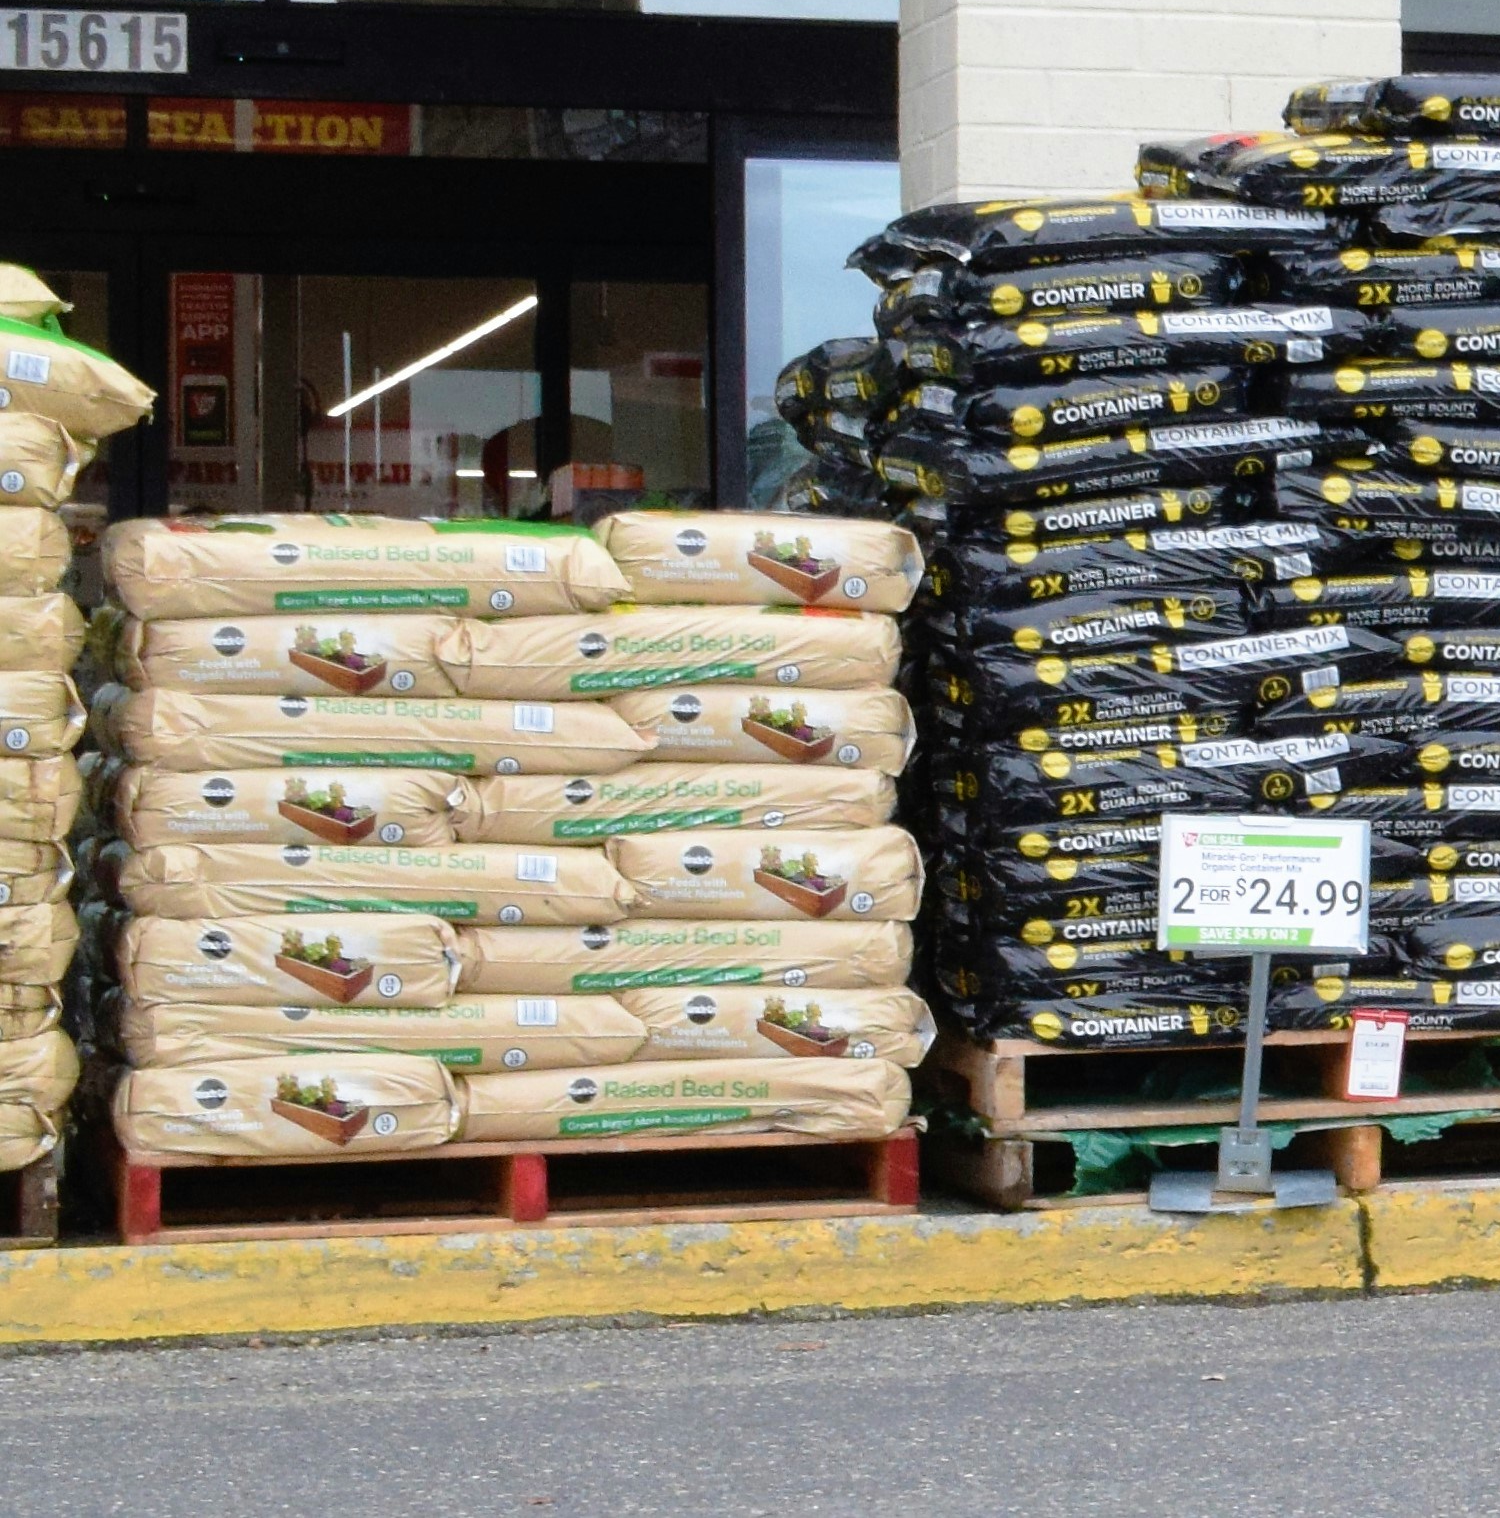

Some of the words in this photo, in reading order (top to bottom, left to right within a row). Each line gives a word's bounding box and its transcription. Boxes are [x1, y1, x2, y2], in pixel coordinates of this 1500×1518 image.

[7, 12, 183, 71] 15615
[20, 107, 384, 149] SATSFATION
[1304, 185, 1336, 205] 2X
[1161, 207, 1278, 221] CONTAINER
[1032, 284, 1145, 307] CONTAINER
[1358, 284, 1392, 305] 2X
[1397, 284, 1431, 293] MORE
[1290, 309, 1325, 326] MIX
[1052, 393, 1164, 422] CONTAINER
[1156, 422, 1270, 442] CONTAINER
[1044, 503, 1156, 531] CONTAINER
[308, 545, 379, 561] Raised
[387, 545, 429, 562] Bed
[436, 545, 475, 563] Soil
[1029, 575, 1063, 598] 2X
[1050, 612, 1160, 645] CONTAINER
[614, 635, 683, 654] Raised
[690, 634, 733, 653] Bed
[740, 633, 776, 652] Soil
[1181, 638, 1298, 662] CONTAINER
[1306, 628, 1342, 646] MIX
[314, 697, 388, 717] Raised
[395, 698, 436, 719] Bed
[442, 699, 482, 721] Soil
[1057, 701, 1091, 724] 2X
[1060, 725, 1172, 748] CONTAINER
[1306, 735, 1342, 753] MIX
[600, 781, 668, 800] Raised
[675, 780, 718, 798] Bed
[725, 779, 762, 798] Soil
[1061, 792, 1096, 816] 2X
[1202, 834, 1217, 845] ON
[1219, 835, 1244, 846] SALE
[319, 847, 390, 865] Raised
[397, 848, 440, 870] Bed
[447, 851, 486, 871] Soil
[1201, 862, 1236, 873] Organic
[1239, 863, 1283, 873] Container
[1286, 864, 1302, 873] Mix
[1262, 853, 1321, 864] Performance
[1173, 877, 1195, 914] 2
[1200, 888, 1230, 902] FOR
[1235, 876, 1363, 916] $24.99
[617, 929, 687, 947] Raised
[694, 928, 737, 946] Bed
[744, 927, 780, 947] Soil
[1200, 927, 1232, 940] SAVE
[1234, 927, 1267, 941] $4.99
[1270, 929, 1288, 941] ON
[1290, 929, 1299, 941] 2
[1071, 1016, 1184, 1037] CONTAINER
[605, 1081, 675, 1099] Raised
[682, 1079, 725, 1098] Bed
[732, 1080, 769, 1099] Soil
